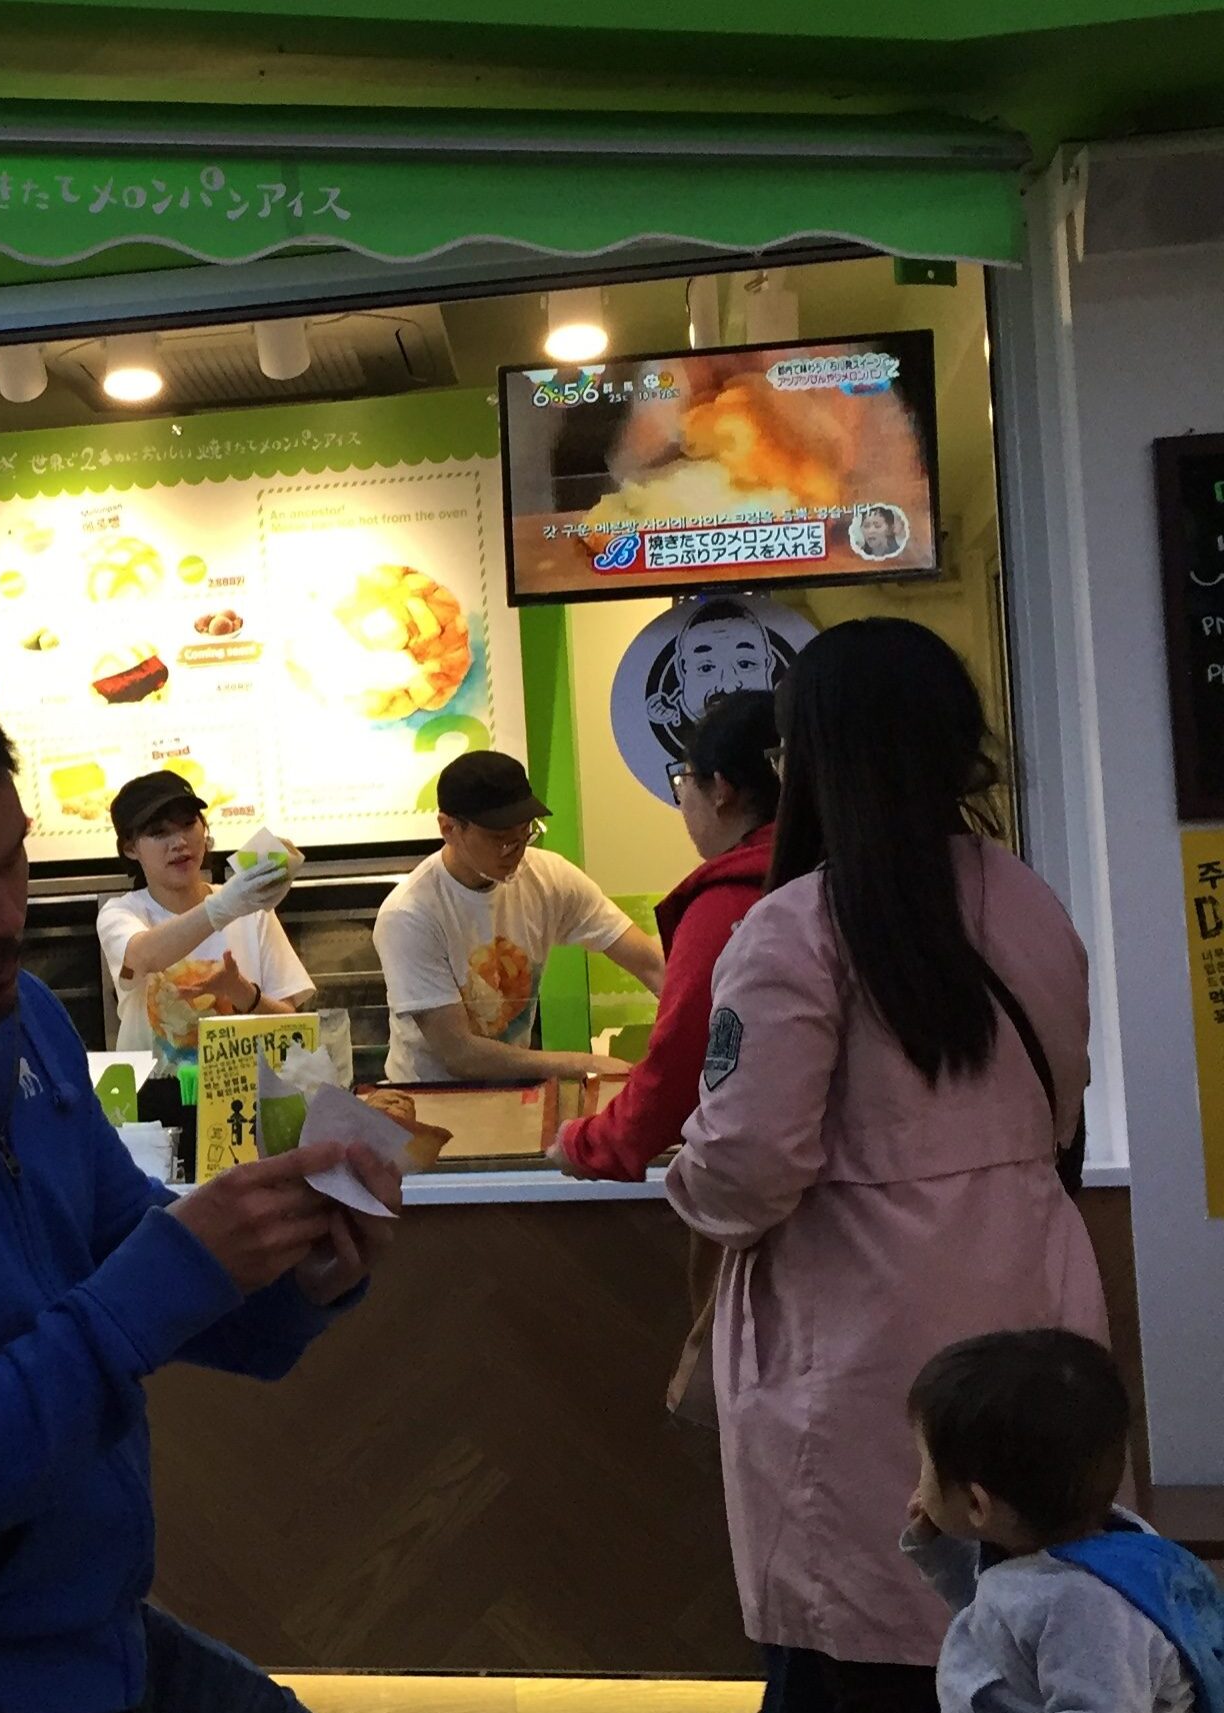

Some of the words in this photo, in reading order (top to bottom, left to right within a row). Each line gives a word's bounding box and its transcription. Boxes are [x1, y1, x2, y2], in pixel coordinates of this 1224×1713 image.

[533, 381, 599, 407] 6:56
[381, 513, 412, 525] from
[415, 511, 435, 522] the
[438, 508, 468, 520] oven
[648, 541, 824, 566] たっぷりアイスを入れる
[151, 746, 191, 760] Bread
[205, 1026, 236, 1042] 주의!
